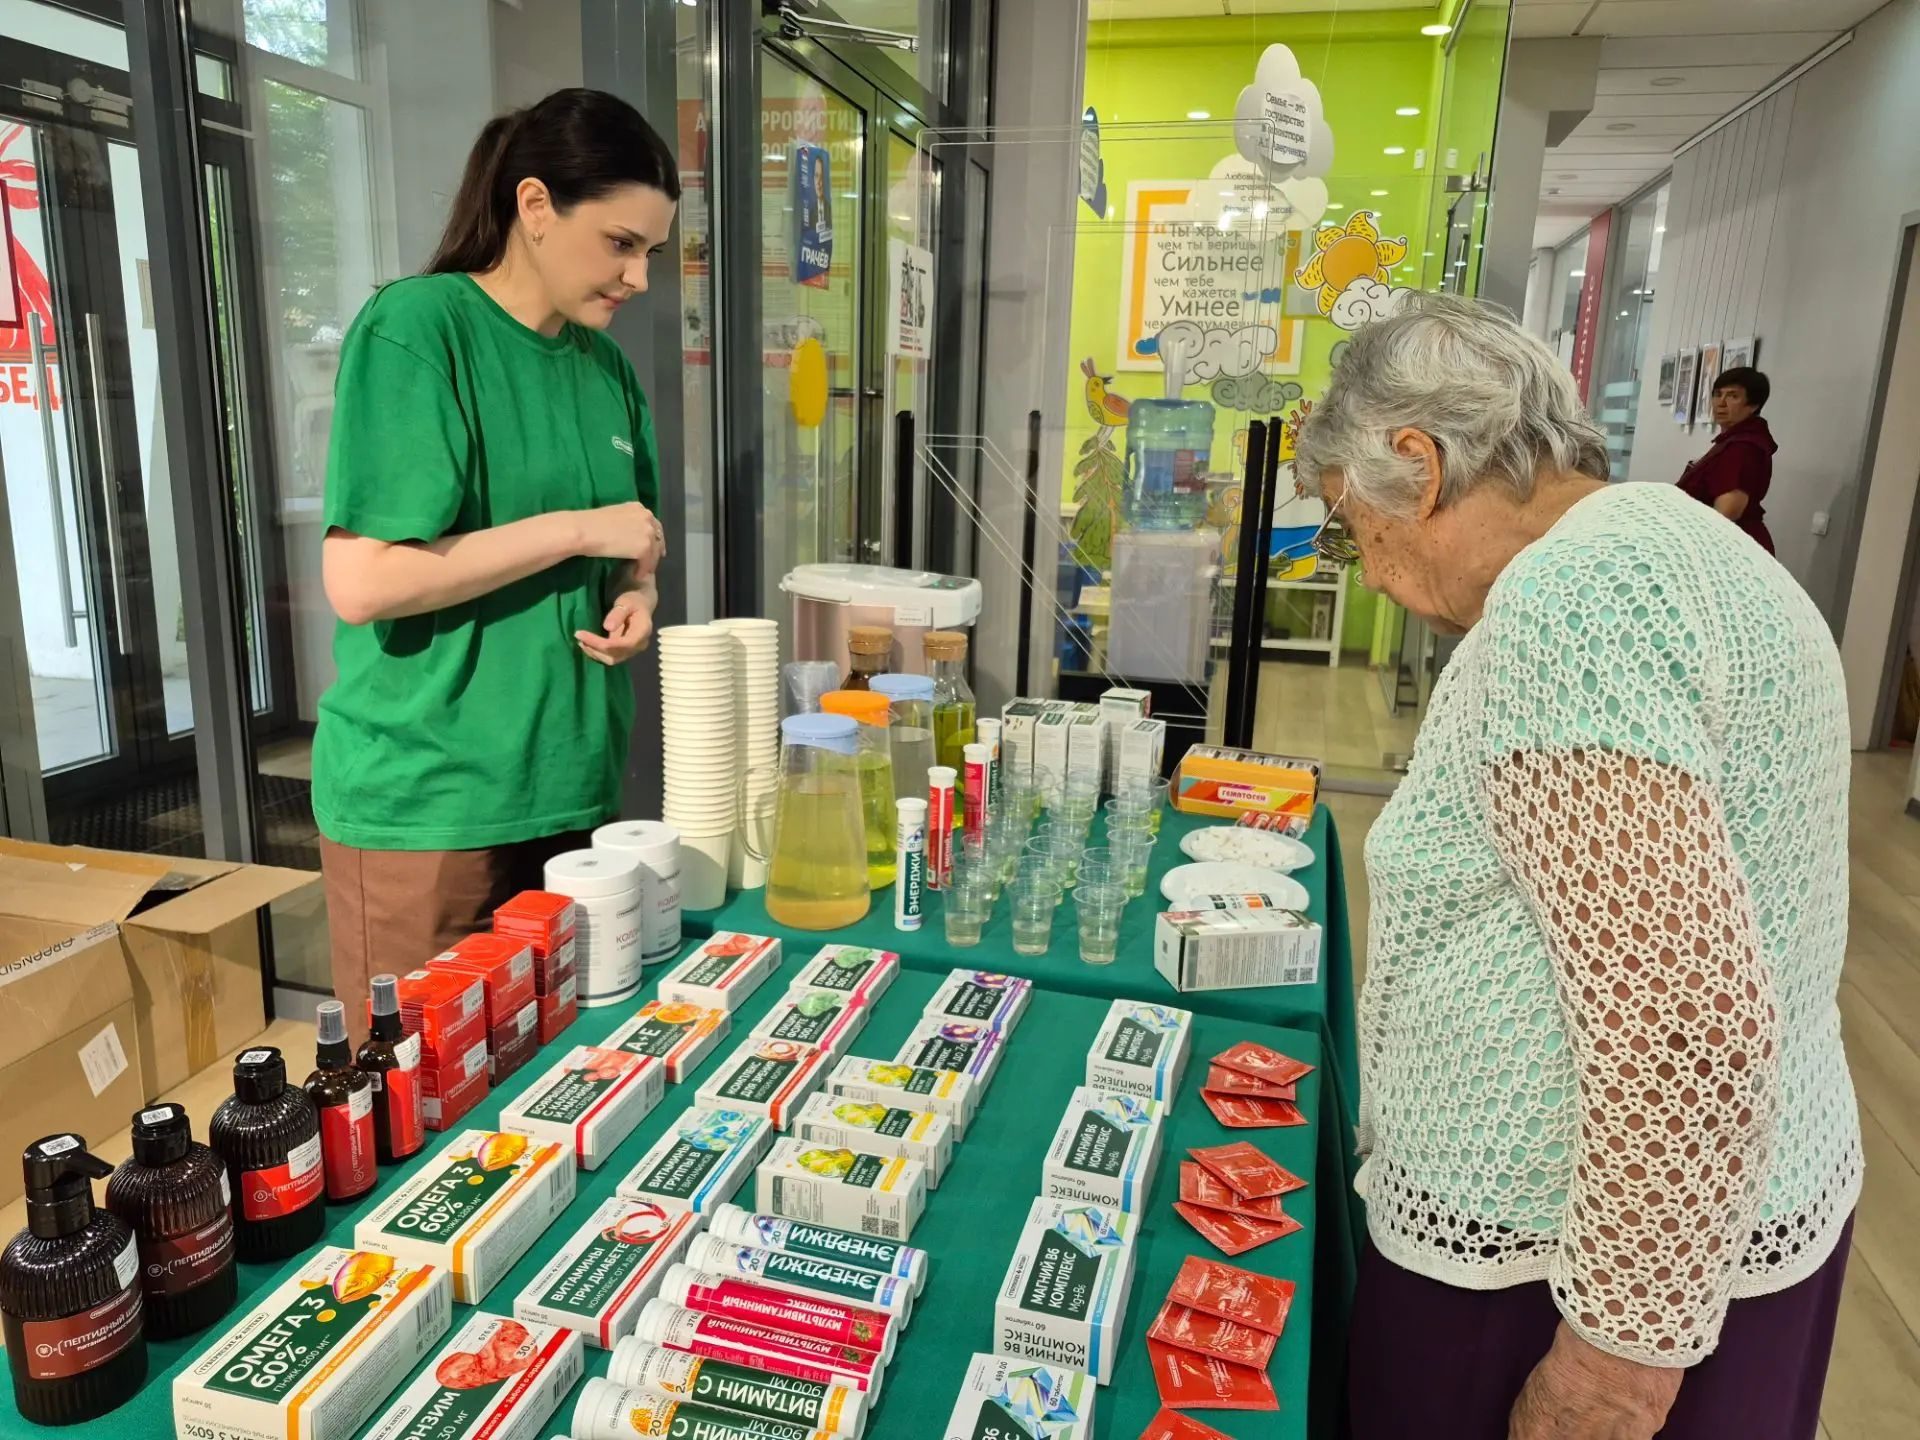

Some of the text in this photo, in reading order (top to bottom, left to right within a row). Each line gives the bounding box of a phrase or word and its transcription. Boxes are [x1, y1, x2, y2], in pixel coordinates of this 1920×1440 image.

[1158, 241, 1182, 251] чем
[1162, 251, 1264, 272] Сильнее
[1154, 275, 1215, 287] чем тебе
[1182, 289, 1237, 298] кажется
[1160, 295, 1240, 317] Умнее
[909, 850, 921, 915] ЭНЕРДЖИ
[798, 1026, 811, 1039] 500
[727, 1061, 762, 1095] КОМПЛЕКС
[1093, 1073, 1152, 1093] КОМПЛЕКС
[1073, 1131, 1093, 1166] МАГНИЙ
[1088, 1126, 1113, 1168] КОМПЛЕКС
[648, 1143, 691, 1188] ВИТАМИНЫ
[663, 1155, 697, 1190] ГРУППЫ
[397, 1166, 474, 1229] ОМЕГА 3
[1050, 1184, 1120, 1207] КОМПЛЕКС
[419, 1201, 464, 1233] 60%
[789, 1224, 895, 1264] ЭНЕРДЖИ
[550, 1246, 606, 1302] ВИТАМИНЫ
[568, 1282, 593, 1306] ПРИ
[591, 1242, 630, 1285] ДИАБЕТЕ
[748, 1258, 760, 1272] 20
[769, 1254, 877, 1291] ЭНЕРДЖИ
[1031, 1256, 1053, 1305] МАГНИЙ
[1048, 1251, 1077, 1309] КОМПЛЕКС
[587, 1273, 618, 1309] КОМПЛЕКС
[722, 1294, 843, 1331] МУЛЬТИВИТАМИННЫЙ
[785, 1298, 847, 1319] КОМПЛЕКС
[1004, 1316, 1047, 1331] 60 таблеток
[64, 1313, 125, 1348] ПЕПТИДНЫЙ
[224, 1312, 312, 1384] ОМЕГА
[300, 1296, 327, 1311] 3
[707, 1318, 832, 1353] МУЛЬТИВИТАМИННЫЙ
[1004, 1328, 1086, 1355] КОМПЛЕКС
[250, 1342, 308, 1389] 60%
[516, 1344, 531, 1357] 30
[1024, 1346, 1085, 1368] МАГНИЙ
[273, 1366, 300, 1393] ПНЖК
[298, 1347, 321, 1369] 1200
[506, 1379, 526, 1403] Забота
[716, 1378, 819, 1419] ВИТАМИН
[796, 1380, 823, 1397] 900
[437, 1425, 457, 1440] 30
[649, 1419, 662, 1437] 20
[770, 1424, 804, 1440] 900
